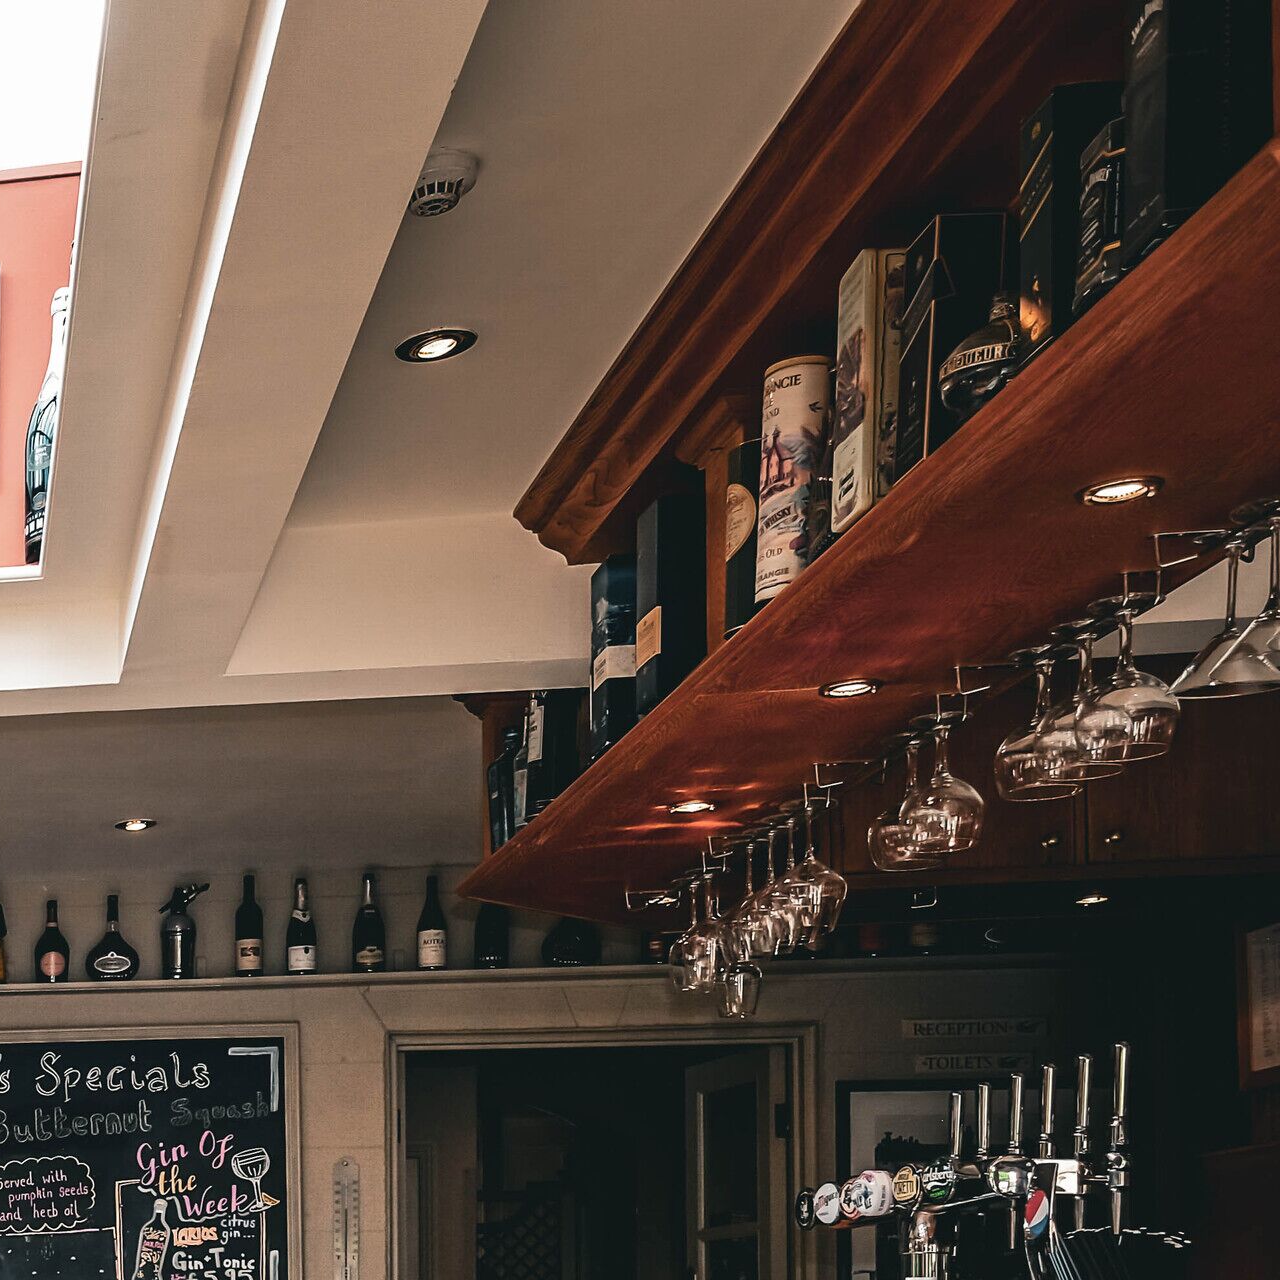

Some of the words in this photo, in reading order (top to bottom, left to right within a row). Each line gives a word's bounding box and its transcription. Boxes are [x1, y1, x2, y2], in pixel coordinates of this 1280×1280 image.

[913, 1021, 1008, 1036] RECEPTION
[926, 1057, 991, 1070] TOILETS
[35, 1050, 211, 1102] Specials
[171, 1091, 270, 1128] Squash
[136, 1142, 189, 1186] Gin
[199, 1130, 234, 1170] Of
[42, 1170, 68, 1185] with
[155, 1164, 198, 1196] the
[8, 1187, 53, 1208] pumpkin
[183, 1184, 255, 1217] Week
[0, 1209, 23, 1222] and
[32, 1203, 58, 1219] herb
[64, 1200, 81, 1218] oil
[220, 1214, 256, 1229] citrus
[171, 1250, 204, 1271] Gin
[208, 1247, 256, 1270] Tonic
